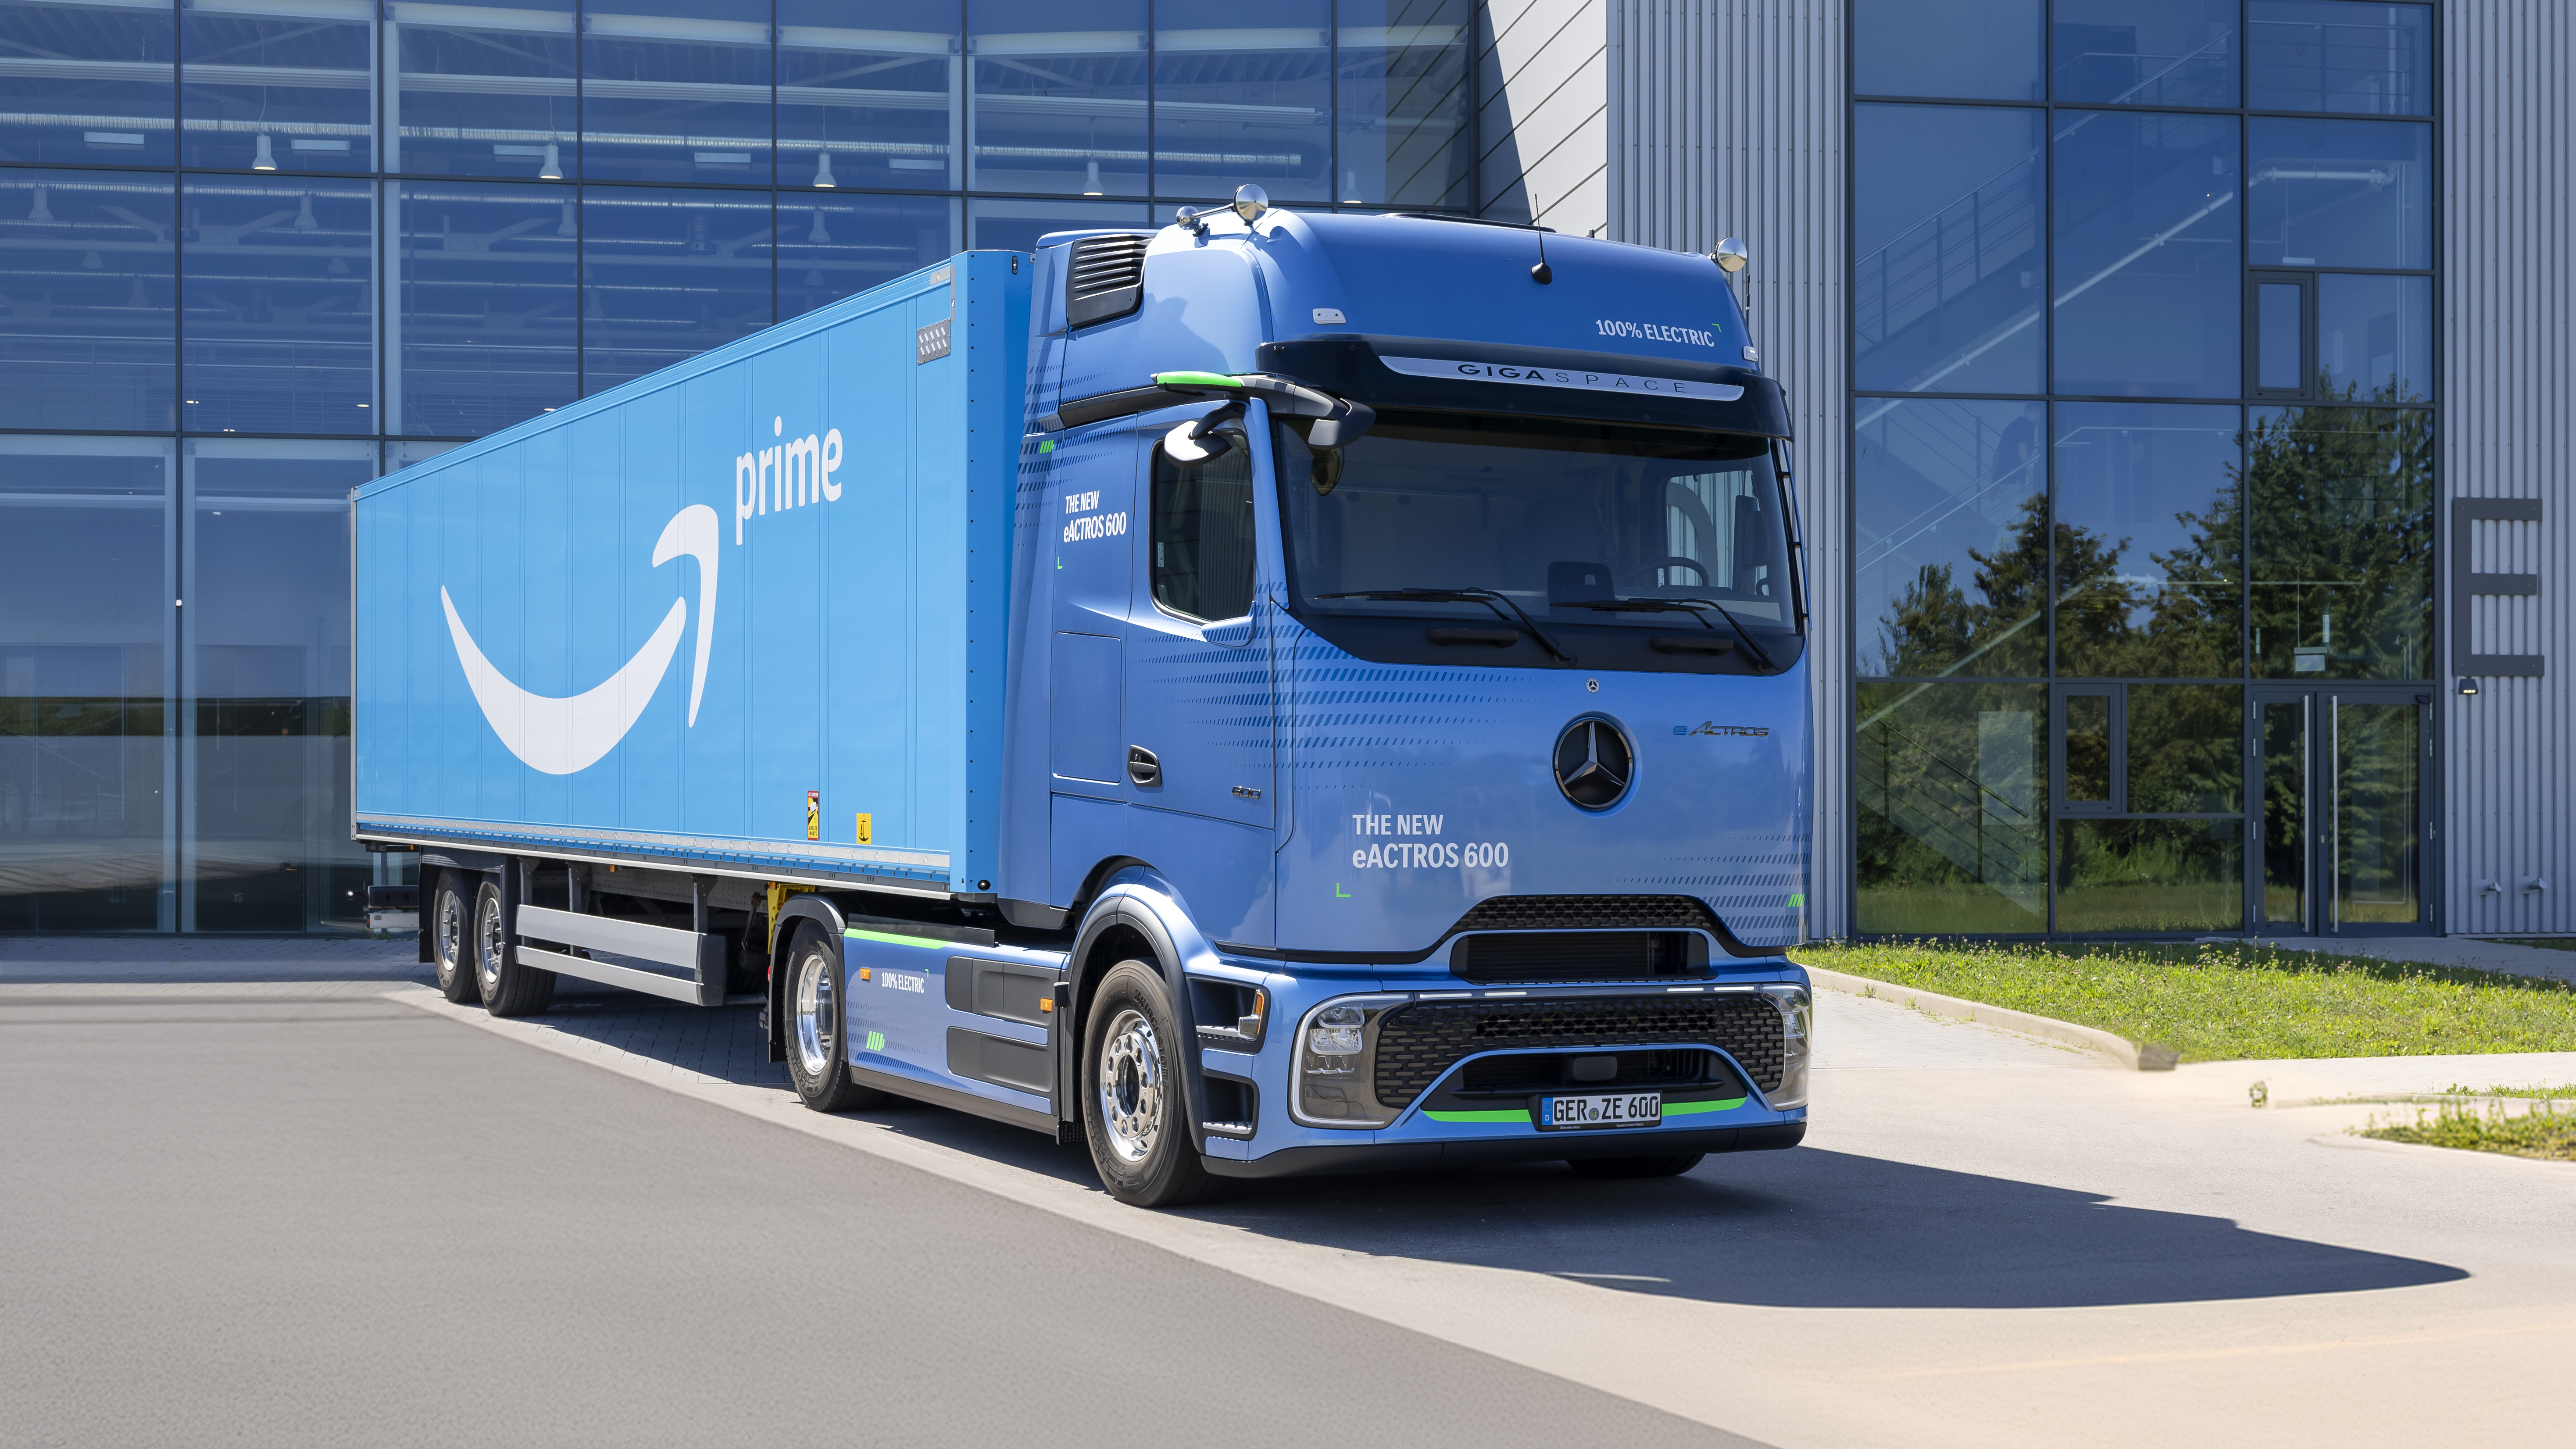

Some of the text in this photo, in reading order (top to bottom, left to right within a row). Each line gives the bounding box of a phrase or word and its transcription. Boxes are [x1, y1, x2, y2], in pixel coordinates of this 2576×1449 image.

[1595, 319, 1715, 347] 100% ELECTRIC
[1457, 364, 1687, 393] GIGASPACE
[736, 416, 843, 546] prime
[1065, 490, 1100, 514] THE NEW
[1063, 511, 1127, 543] eACTROS 600
[2454, 497, 2545, 677] E
[1231, 785, 1261, 800] 600
[1352, 814, 1444, 835] THE NEW
[1352, 842, 1509, 868] eACTROS 600
[881, 971, 925, 994] 100% ELECTRIC
[1133, 988, 1169, 1092] BRIDGESTONE
[1554, 1099, 1587, 1122] GER
[1601, 1097, 1622, 1120] ZE
[1628, 1096, 1659, 1118] 600
